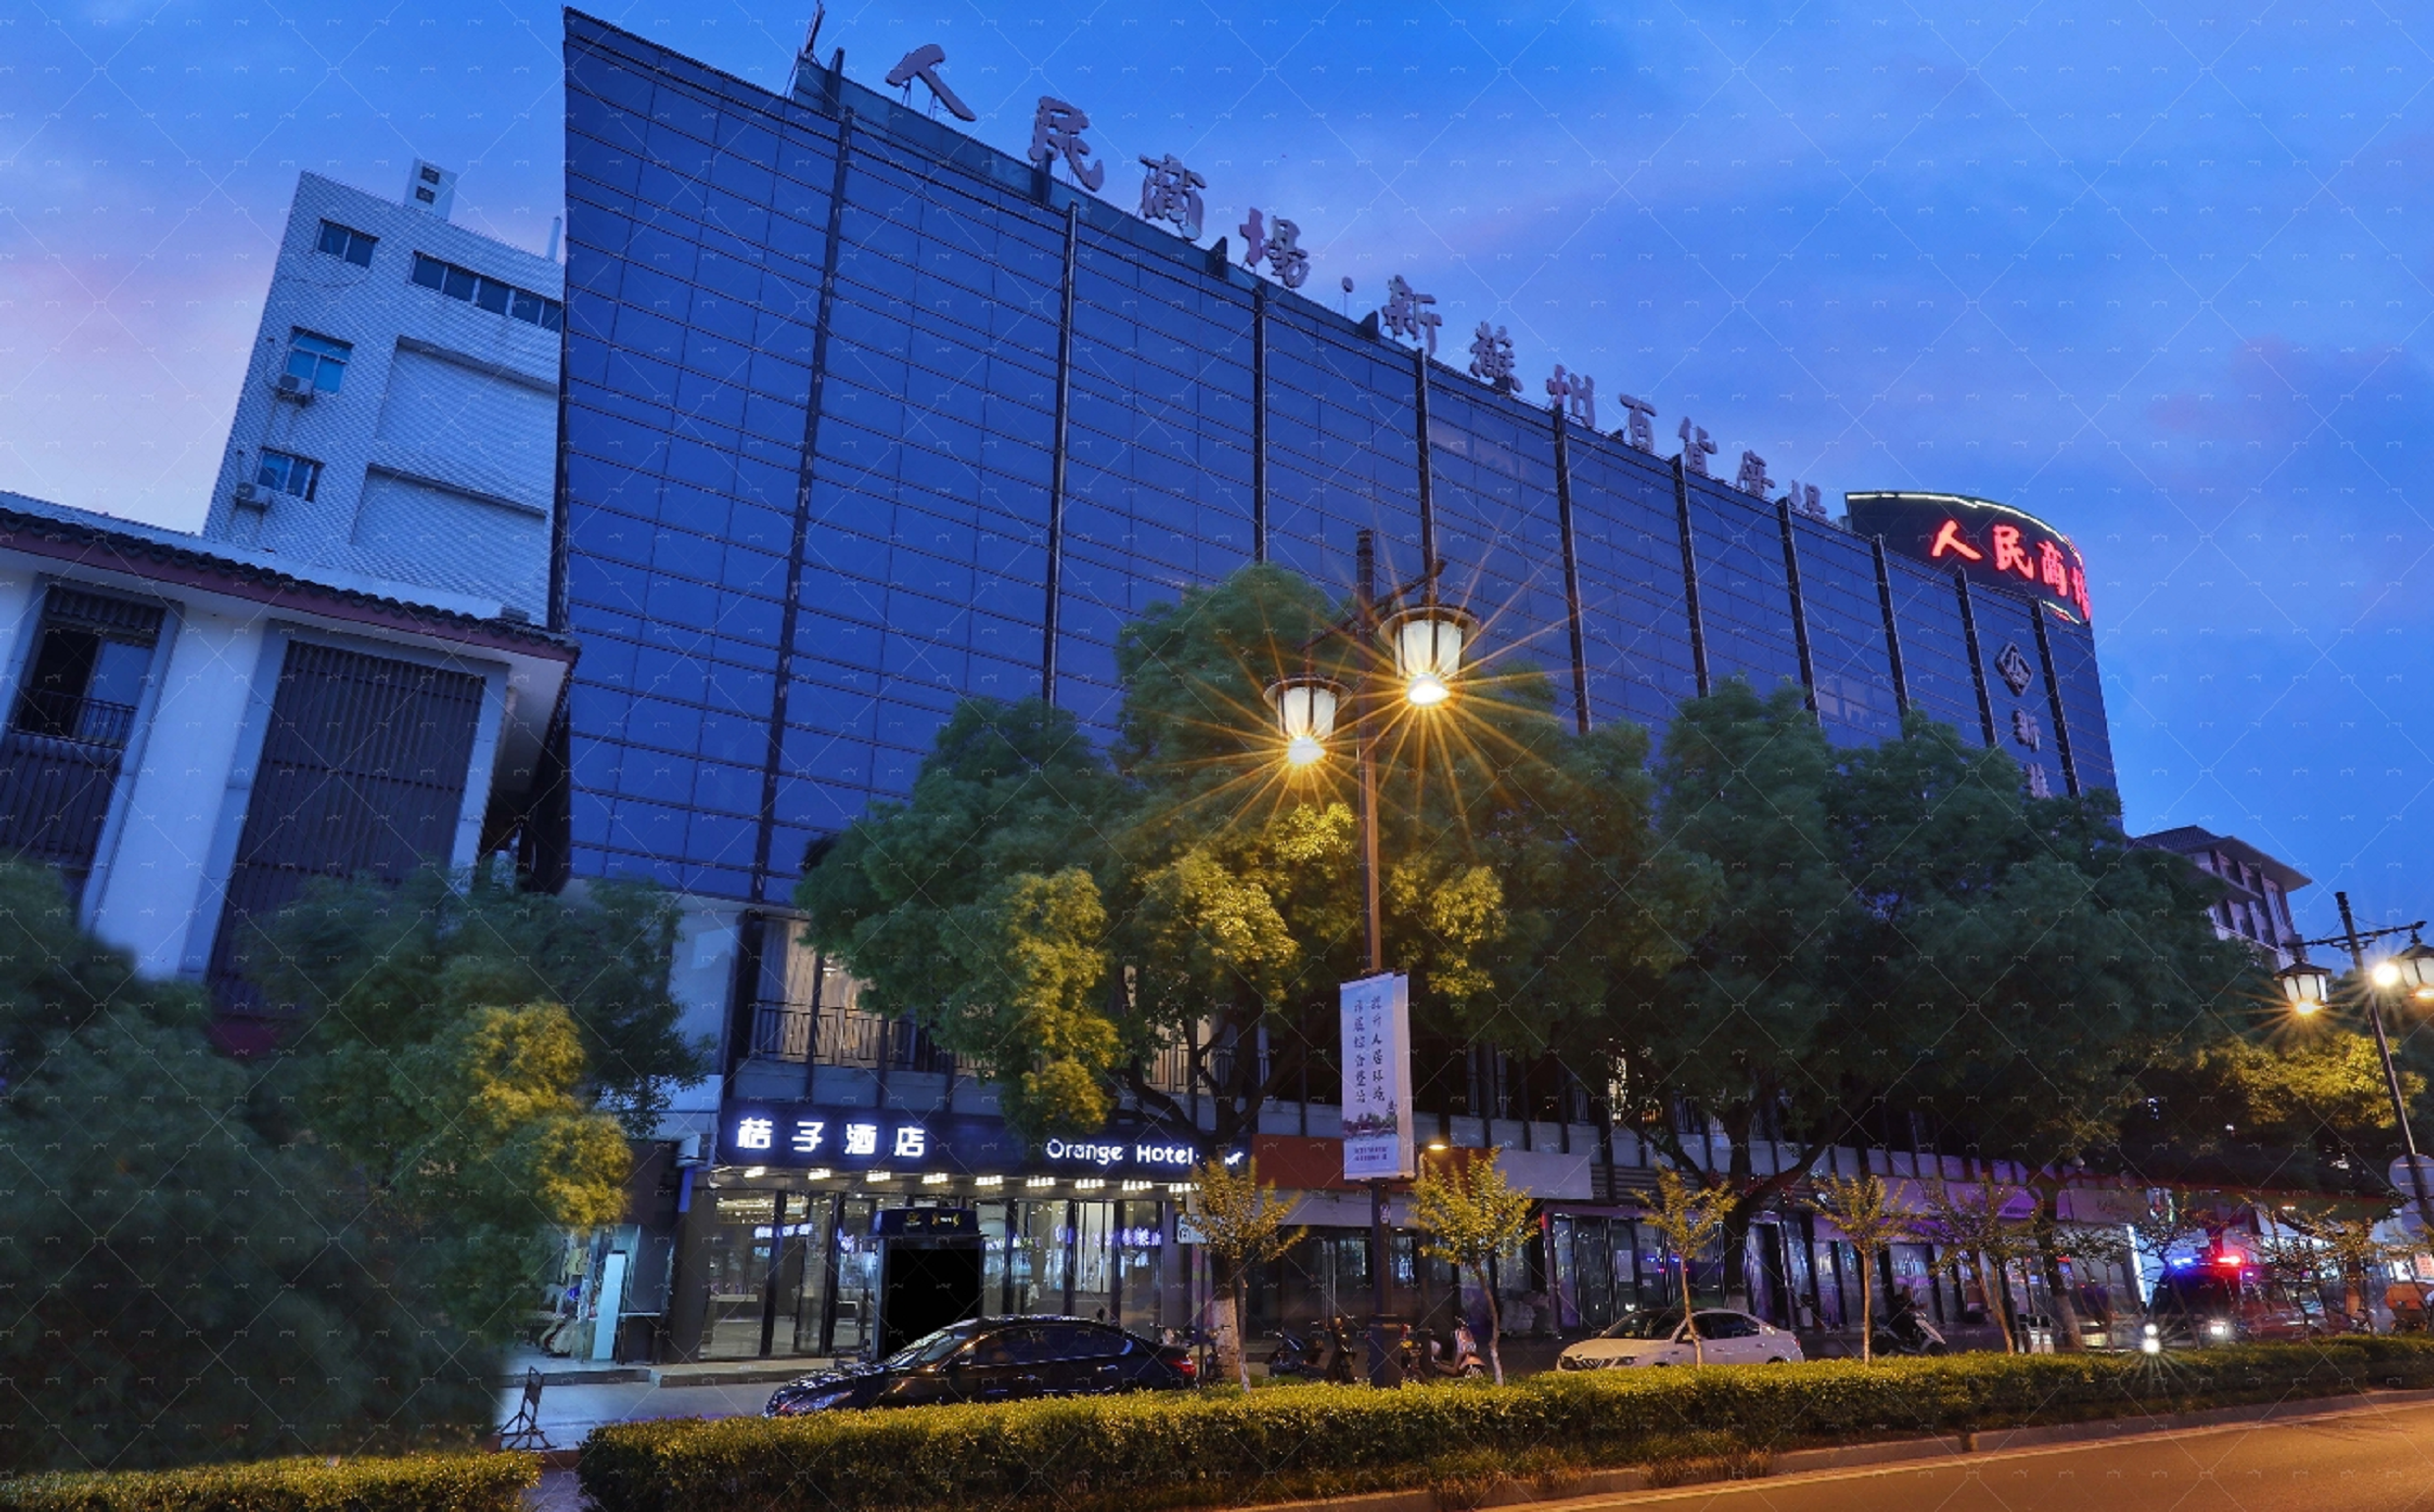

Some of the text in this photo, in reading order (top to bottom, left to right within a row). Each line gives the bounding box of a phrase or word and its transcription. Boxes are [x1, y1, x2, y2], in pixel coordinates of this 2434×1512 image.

[737, 1116, 926, 1158] 桔子酒店
[1046, 1138, 1193, 1166] Orange Hotel
